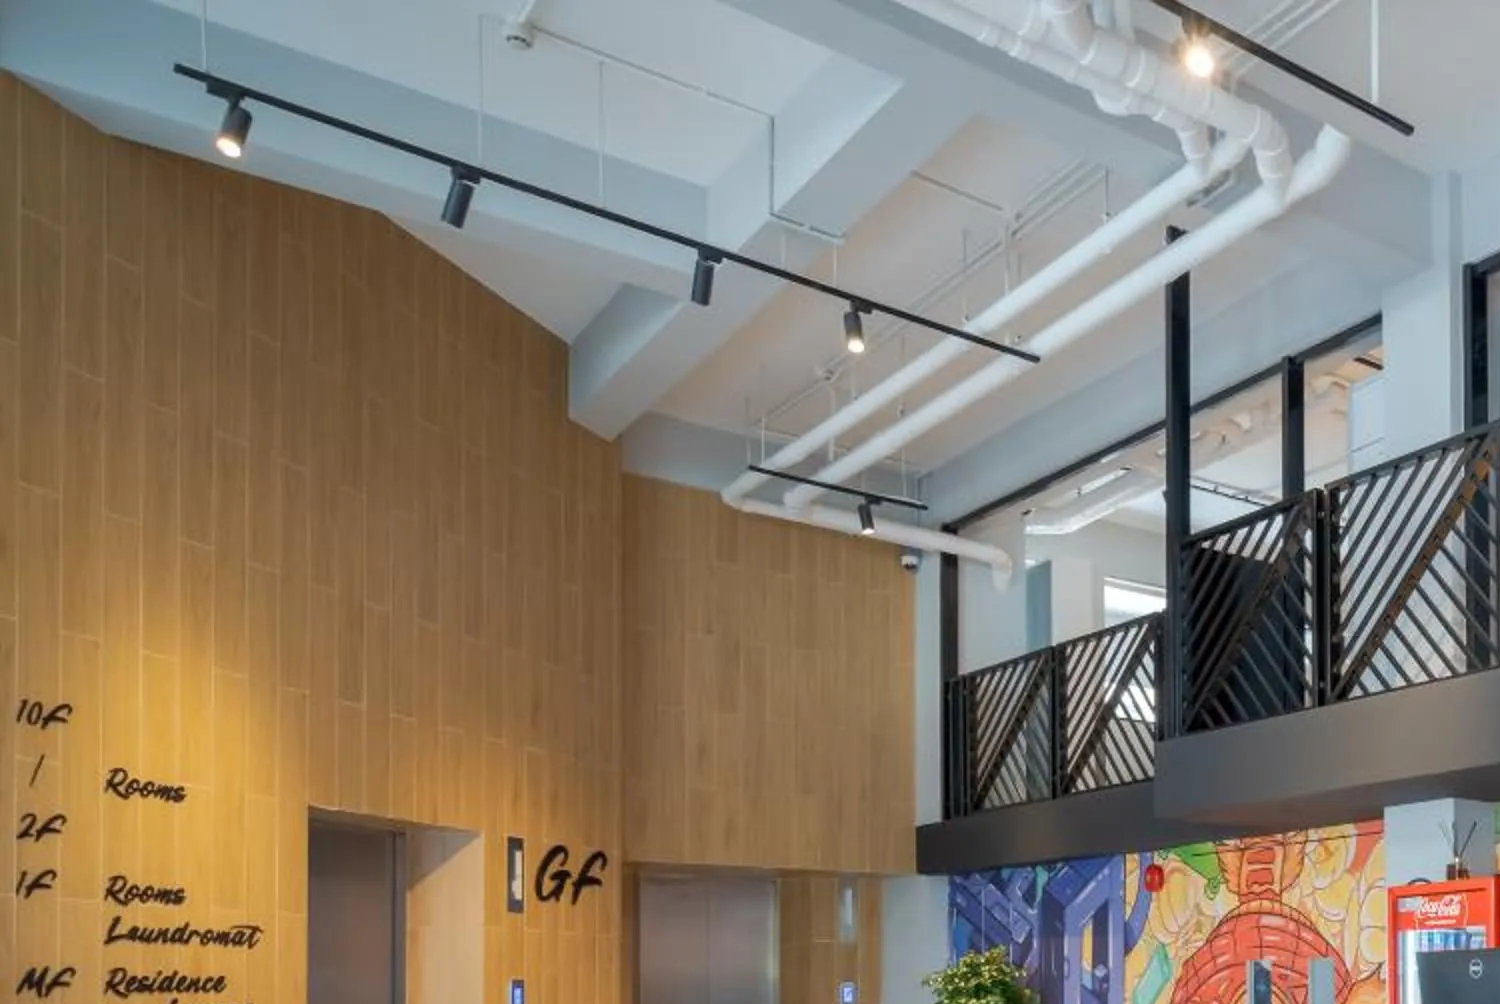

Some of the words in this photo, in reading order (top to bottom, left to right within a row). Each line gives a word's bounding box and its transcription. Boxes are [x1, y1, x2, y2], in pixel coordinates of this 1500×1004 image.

[104, 767, 187, 803] Rooms
[104, 875, 187, 906] Rooms
[103, 915, 264, 949] Laundromat
[104, 967, 227, 999] Residence
